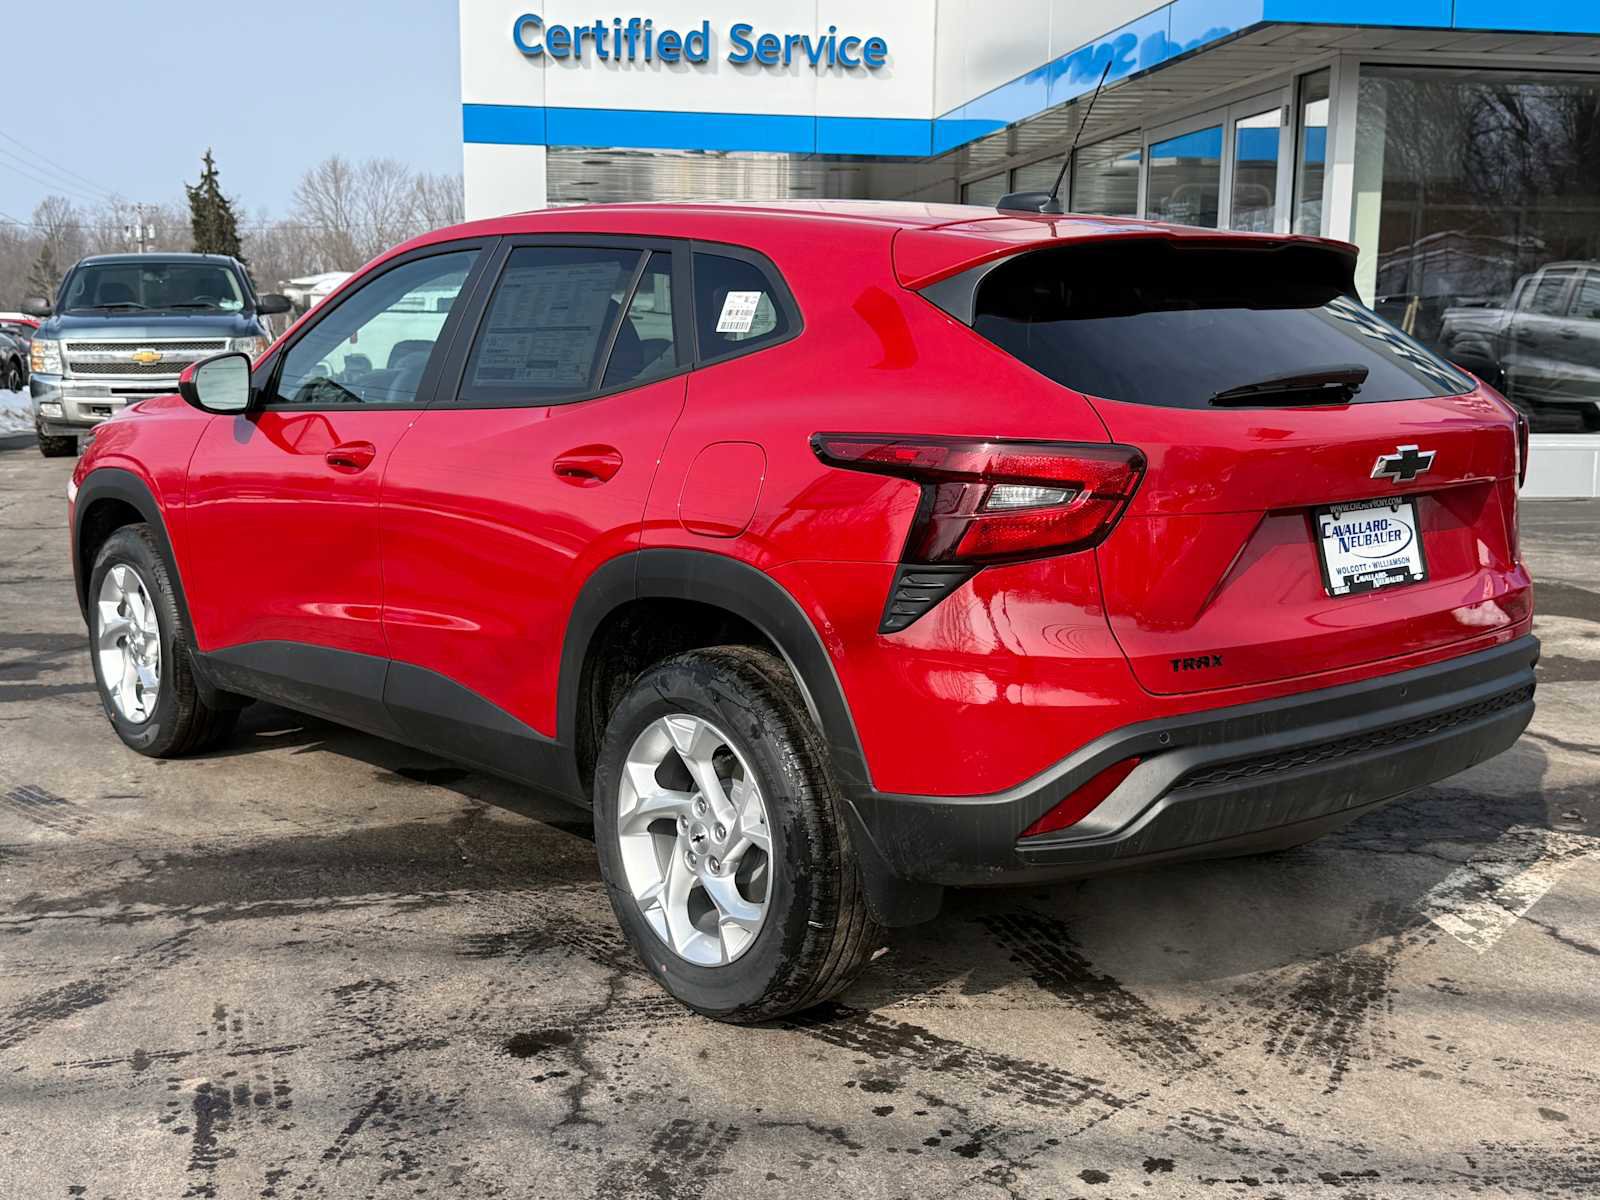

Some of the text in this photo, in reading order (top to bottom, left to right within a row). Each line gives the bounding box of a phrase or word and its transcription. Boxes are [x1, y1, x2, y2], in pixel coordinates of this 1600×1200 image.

[513, 13, 888, 69] Certified Service
[1338, 529, 1402, 554] NEUBAUER
[1335, 556, 1410, 575] WOLCOTT WILLIAMSON
[1170, 655, 1223, 673] TRAX
